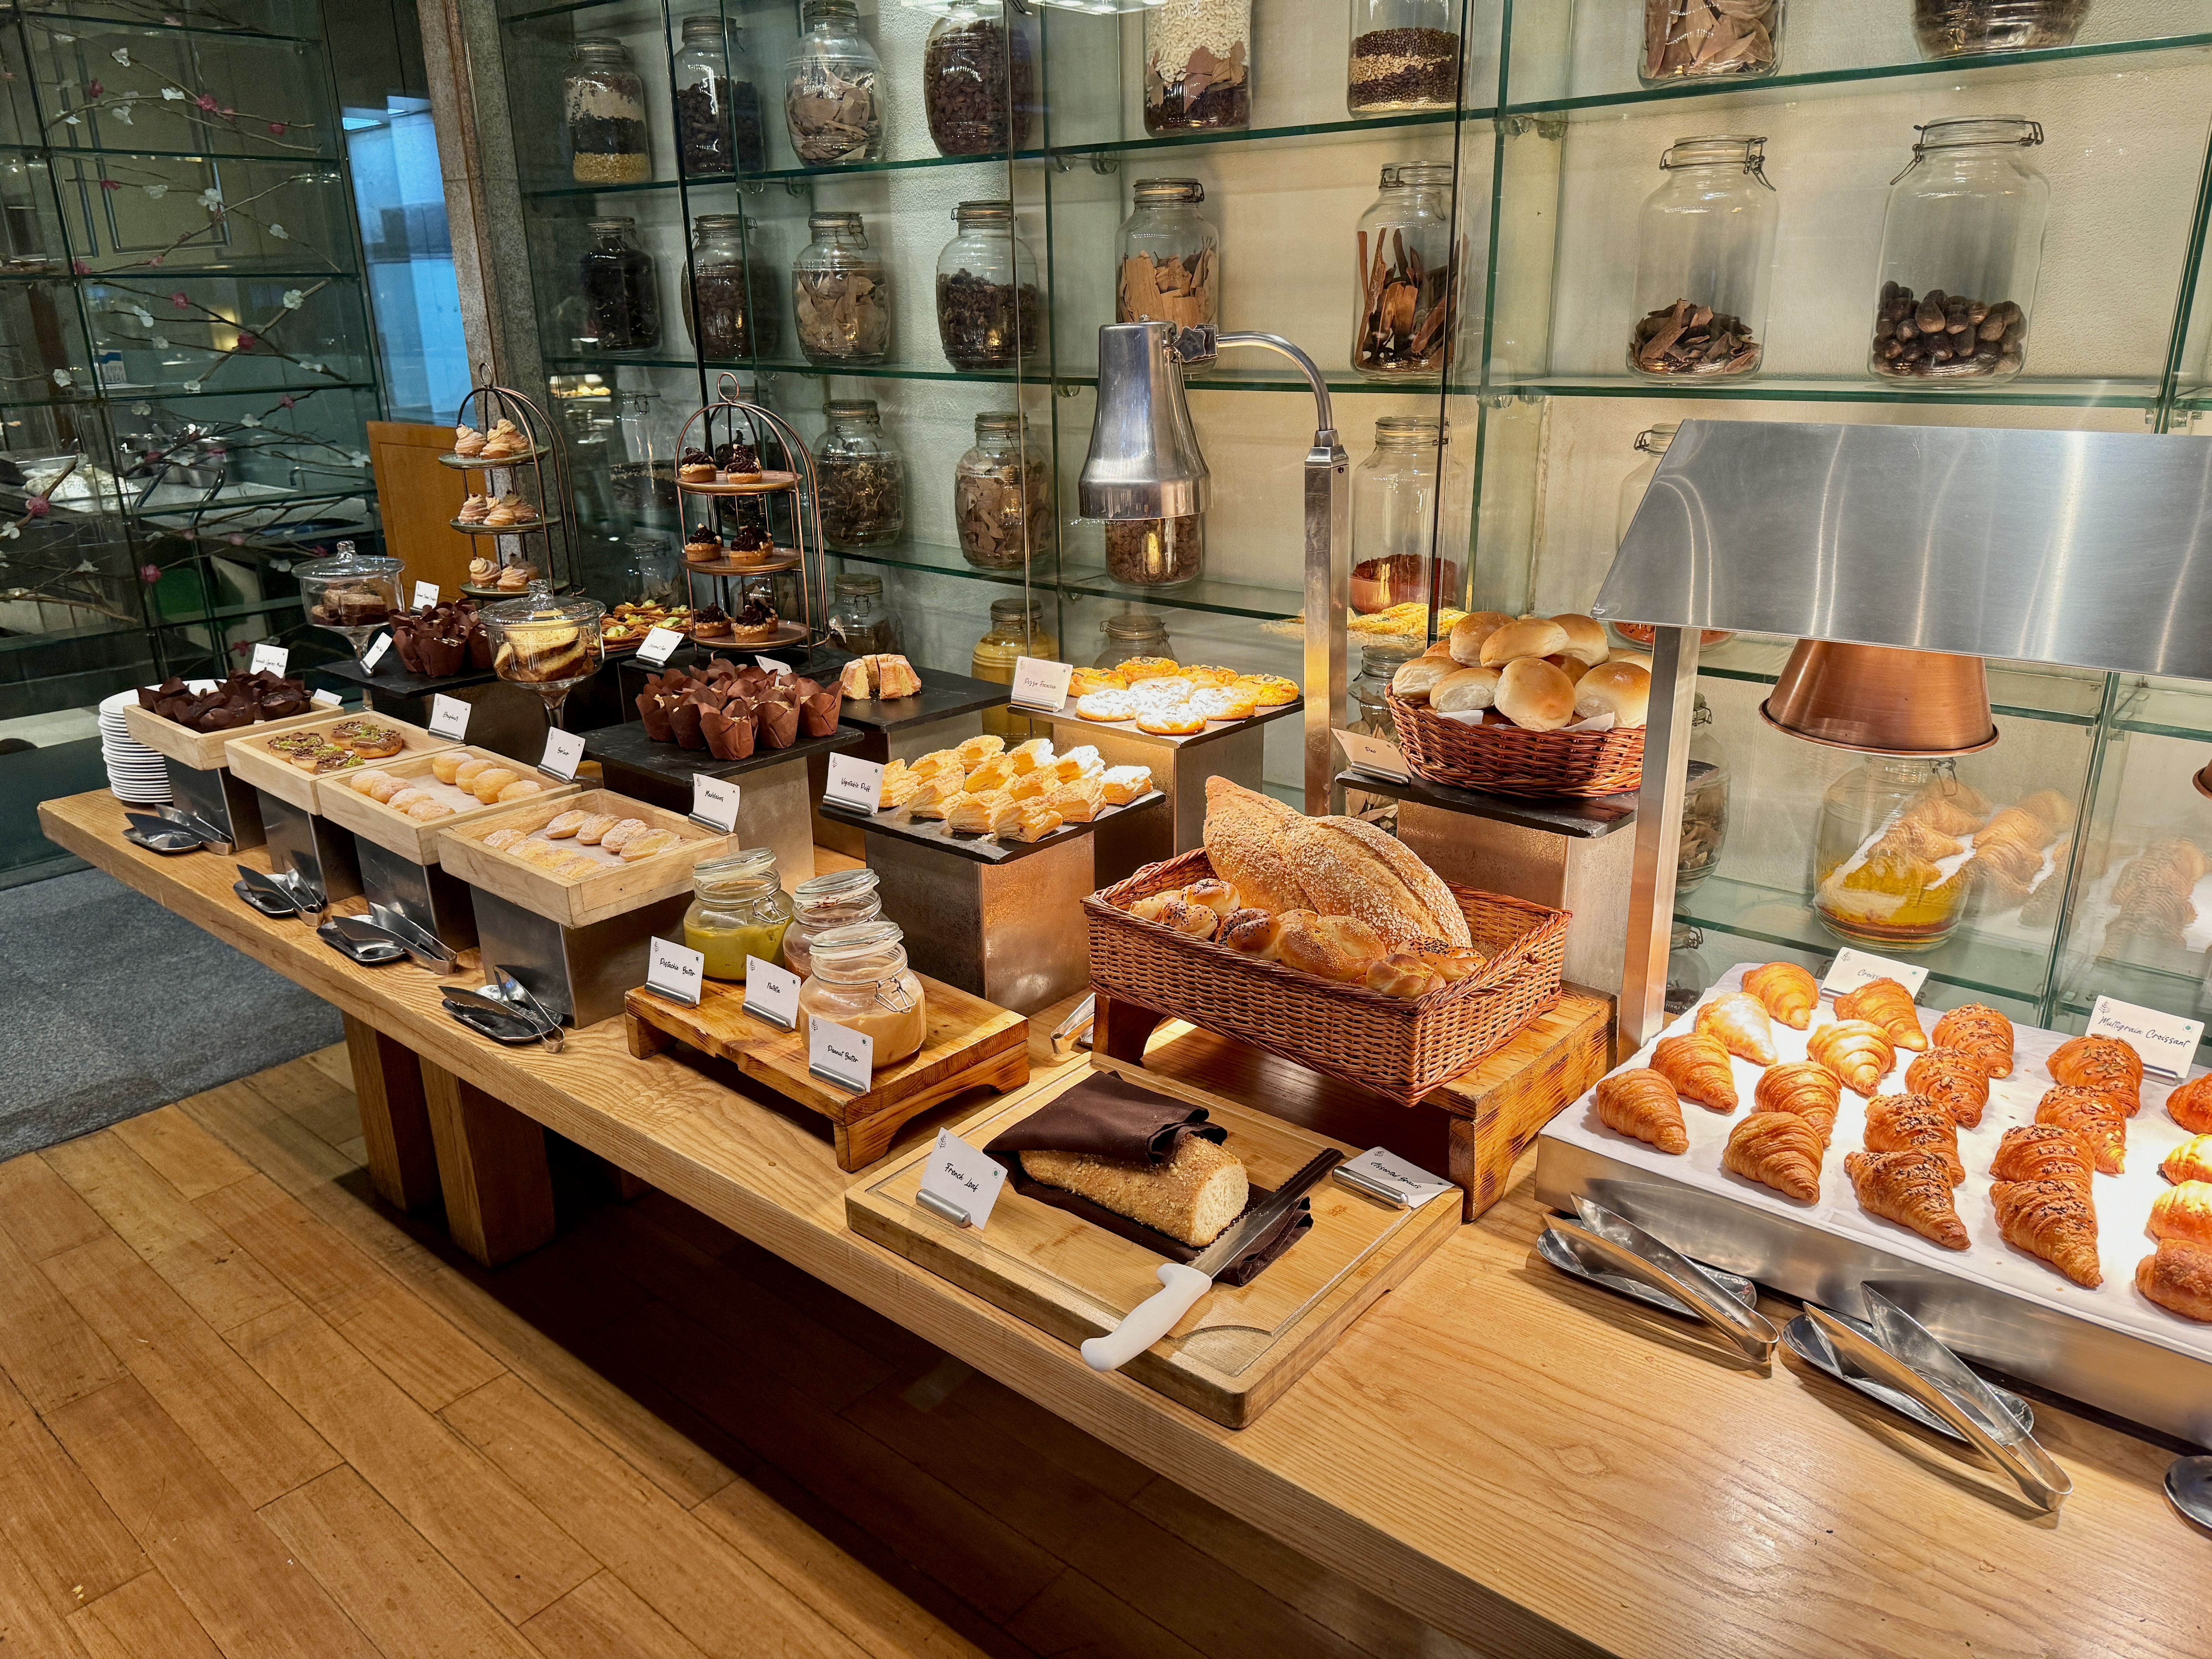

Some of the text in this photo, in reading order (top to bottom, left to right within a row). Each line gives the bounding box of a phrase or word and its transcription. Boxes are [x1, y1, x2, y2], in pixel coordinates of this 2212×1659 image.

[1024, 678, 1038, 687] Pizza
[841, 777, 871, 792] Vegetable Puff
[659, 958, 695, 976] Pistachio Butter
[1857, 969, 1880, 981] Croiss
[767, 982, 780, 993] Nutella
[2098, 1016, 2191, 1047] Multigrain Croissant
[828, 1045, 859, 1063] Peanut Butter
[945, 1163, 979, 1192] French Loaf
[1370, 1162, 1401, 1178] Assorted
